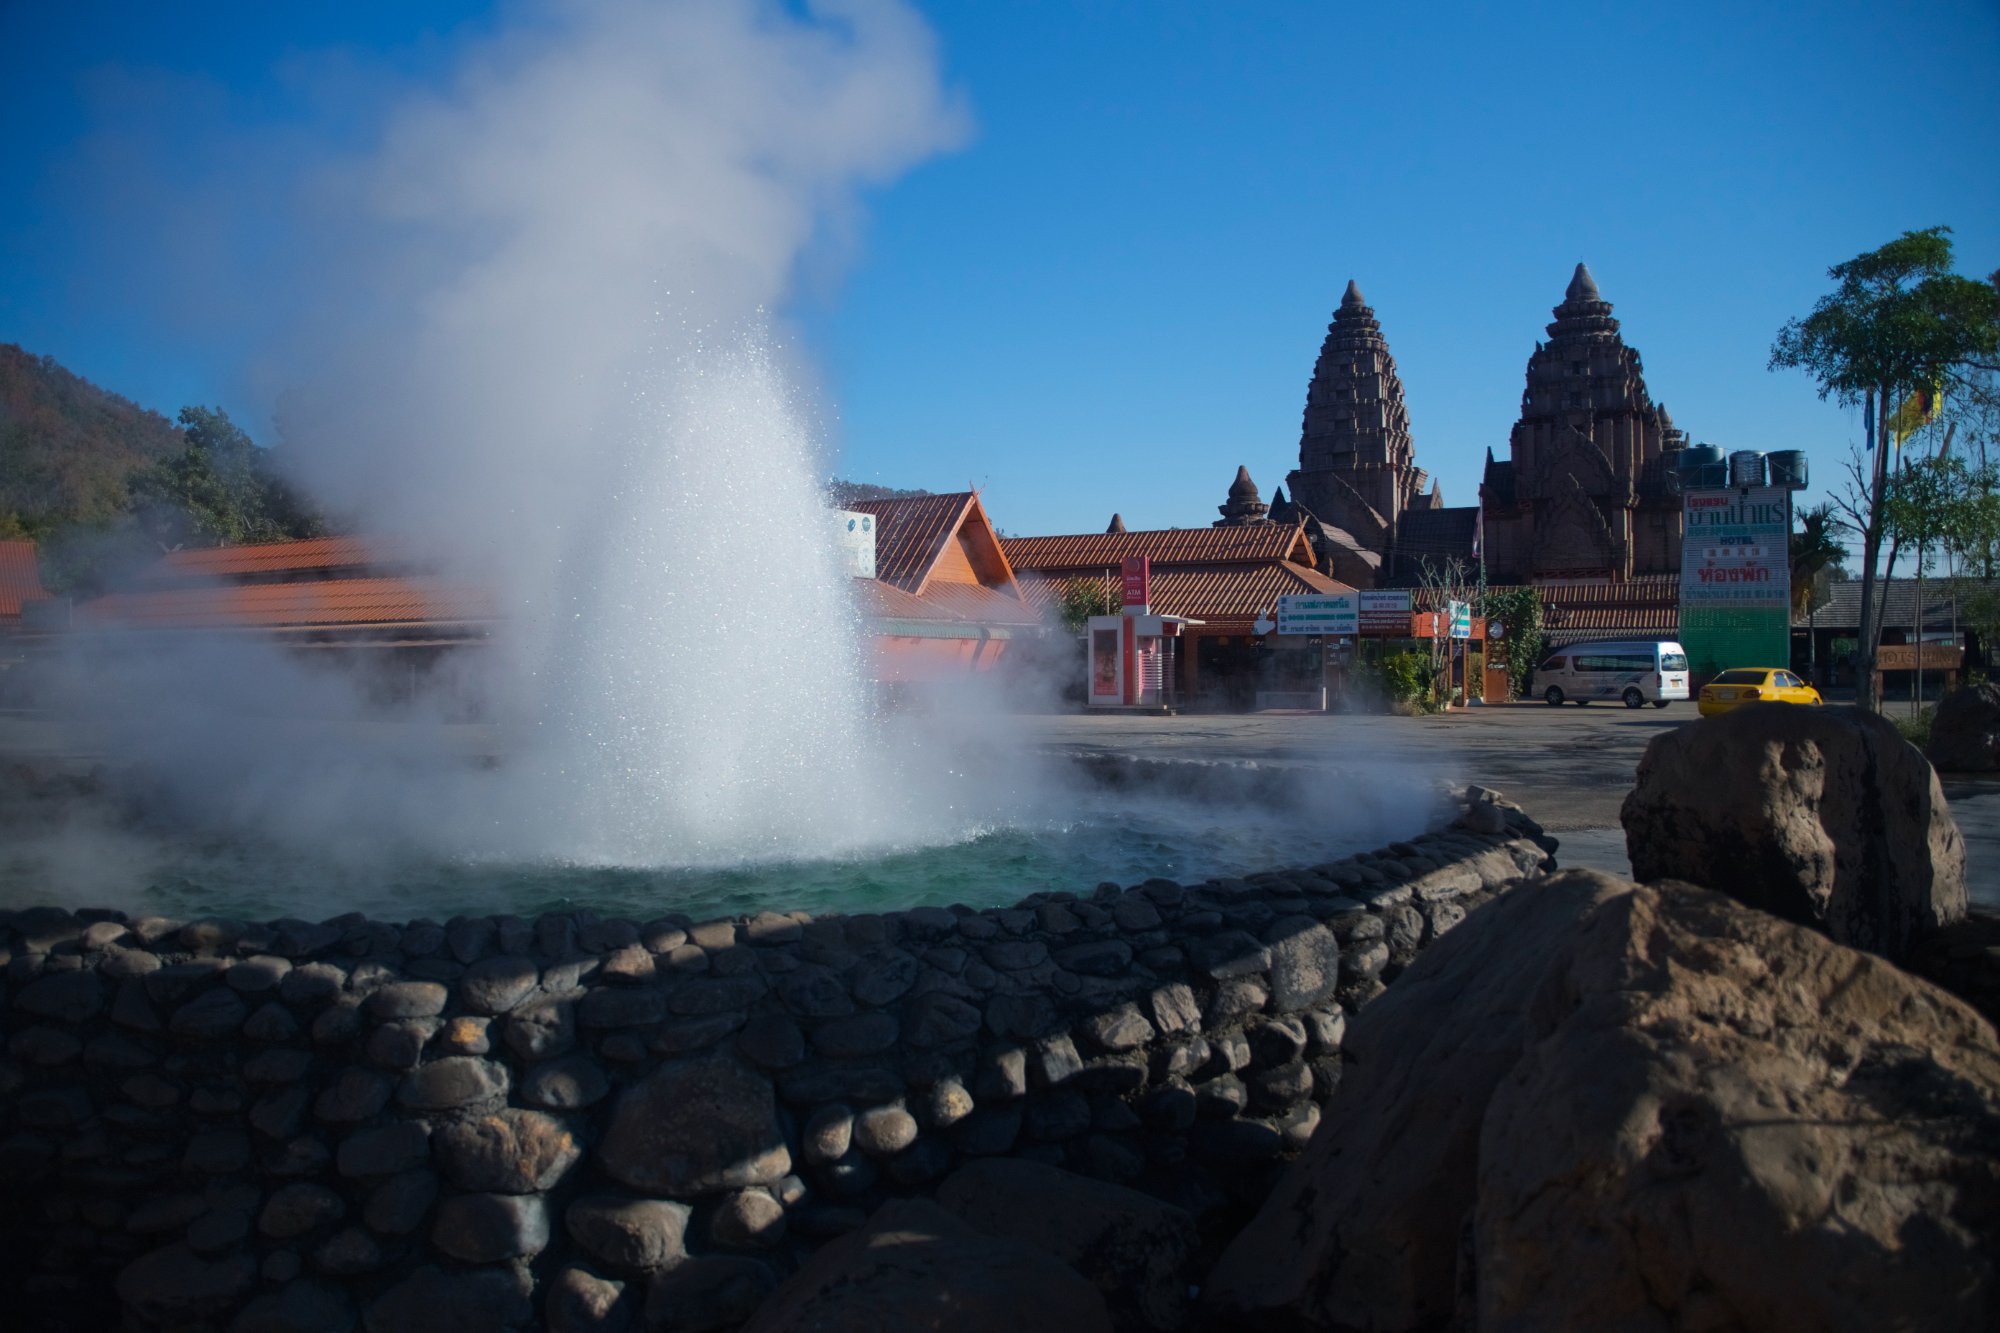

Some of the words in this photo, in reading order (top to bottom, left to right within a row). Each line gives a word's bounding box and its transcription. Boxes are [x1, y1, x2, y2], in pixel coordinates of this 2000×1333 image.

[1720, 536, 1755, 545] HOTEL
[1698, 561, 1768, 582] ห้องพัก
